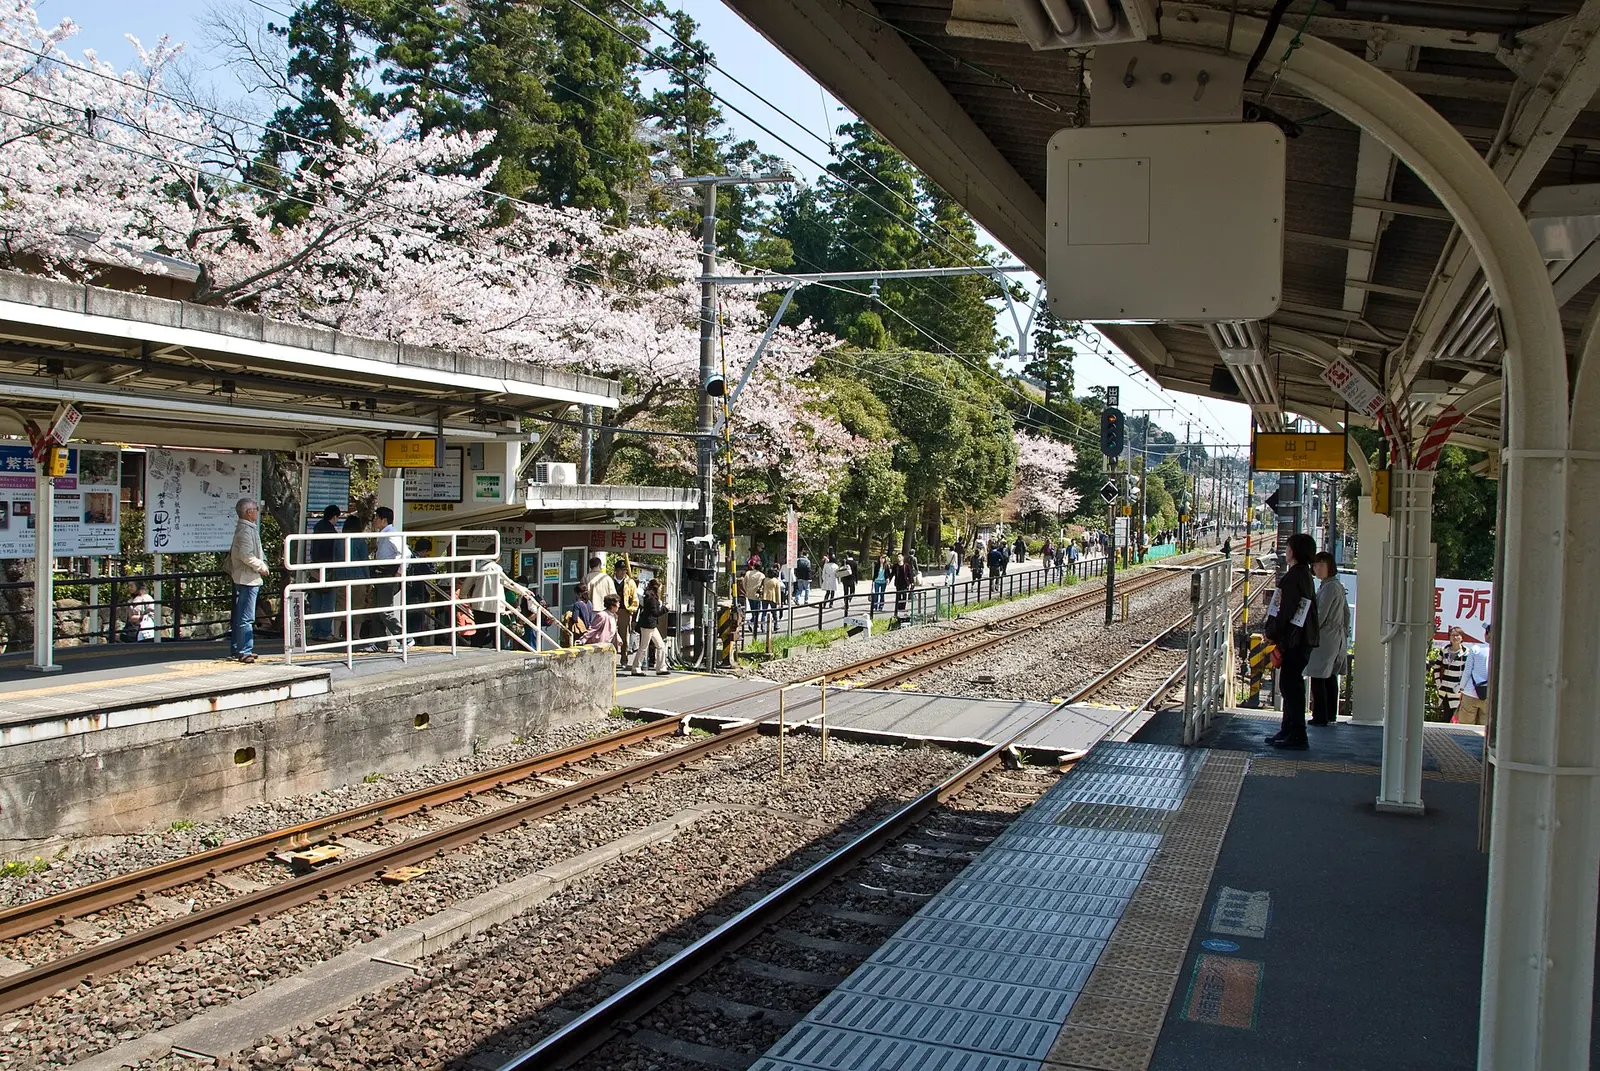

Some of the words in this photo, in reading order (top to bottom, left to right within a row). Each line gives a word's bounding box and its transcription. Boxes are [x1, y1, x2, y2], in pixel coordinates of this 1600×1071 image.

[1108, 387, 1118, 405] 出発
[400, 443, 420, 453] 出口
[1284, 440, 1317, 452] 出口
[591, 530, 667, 549] 臨時出口
